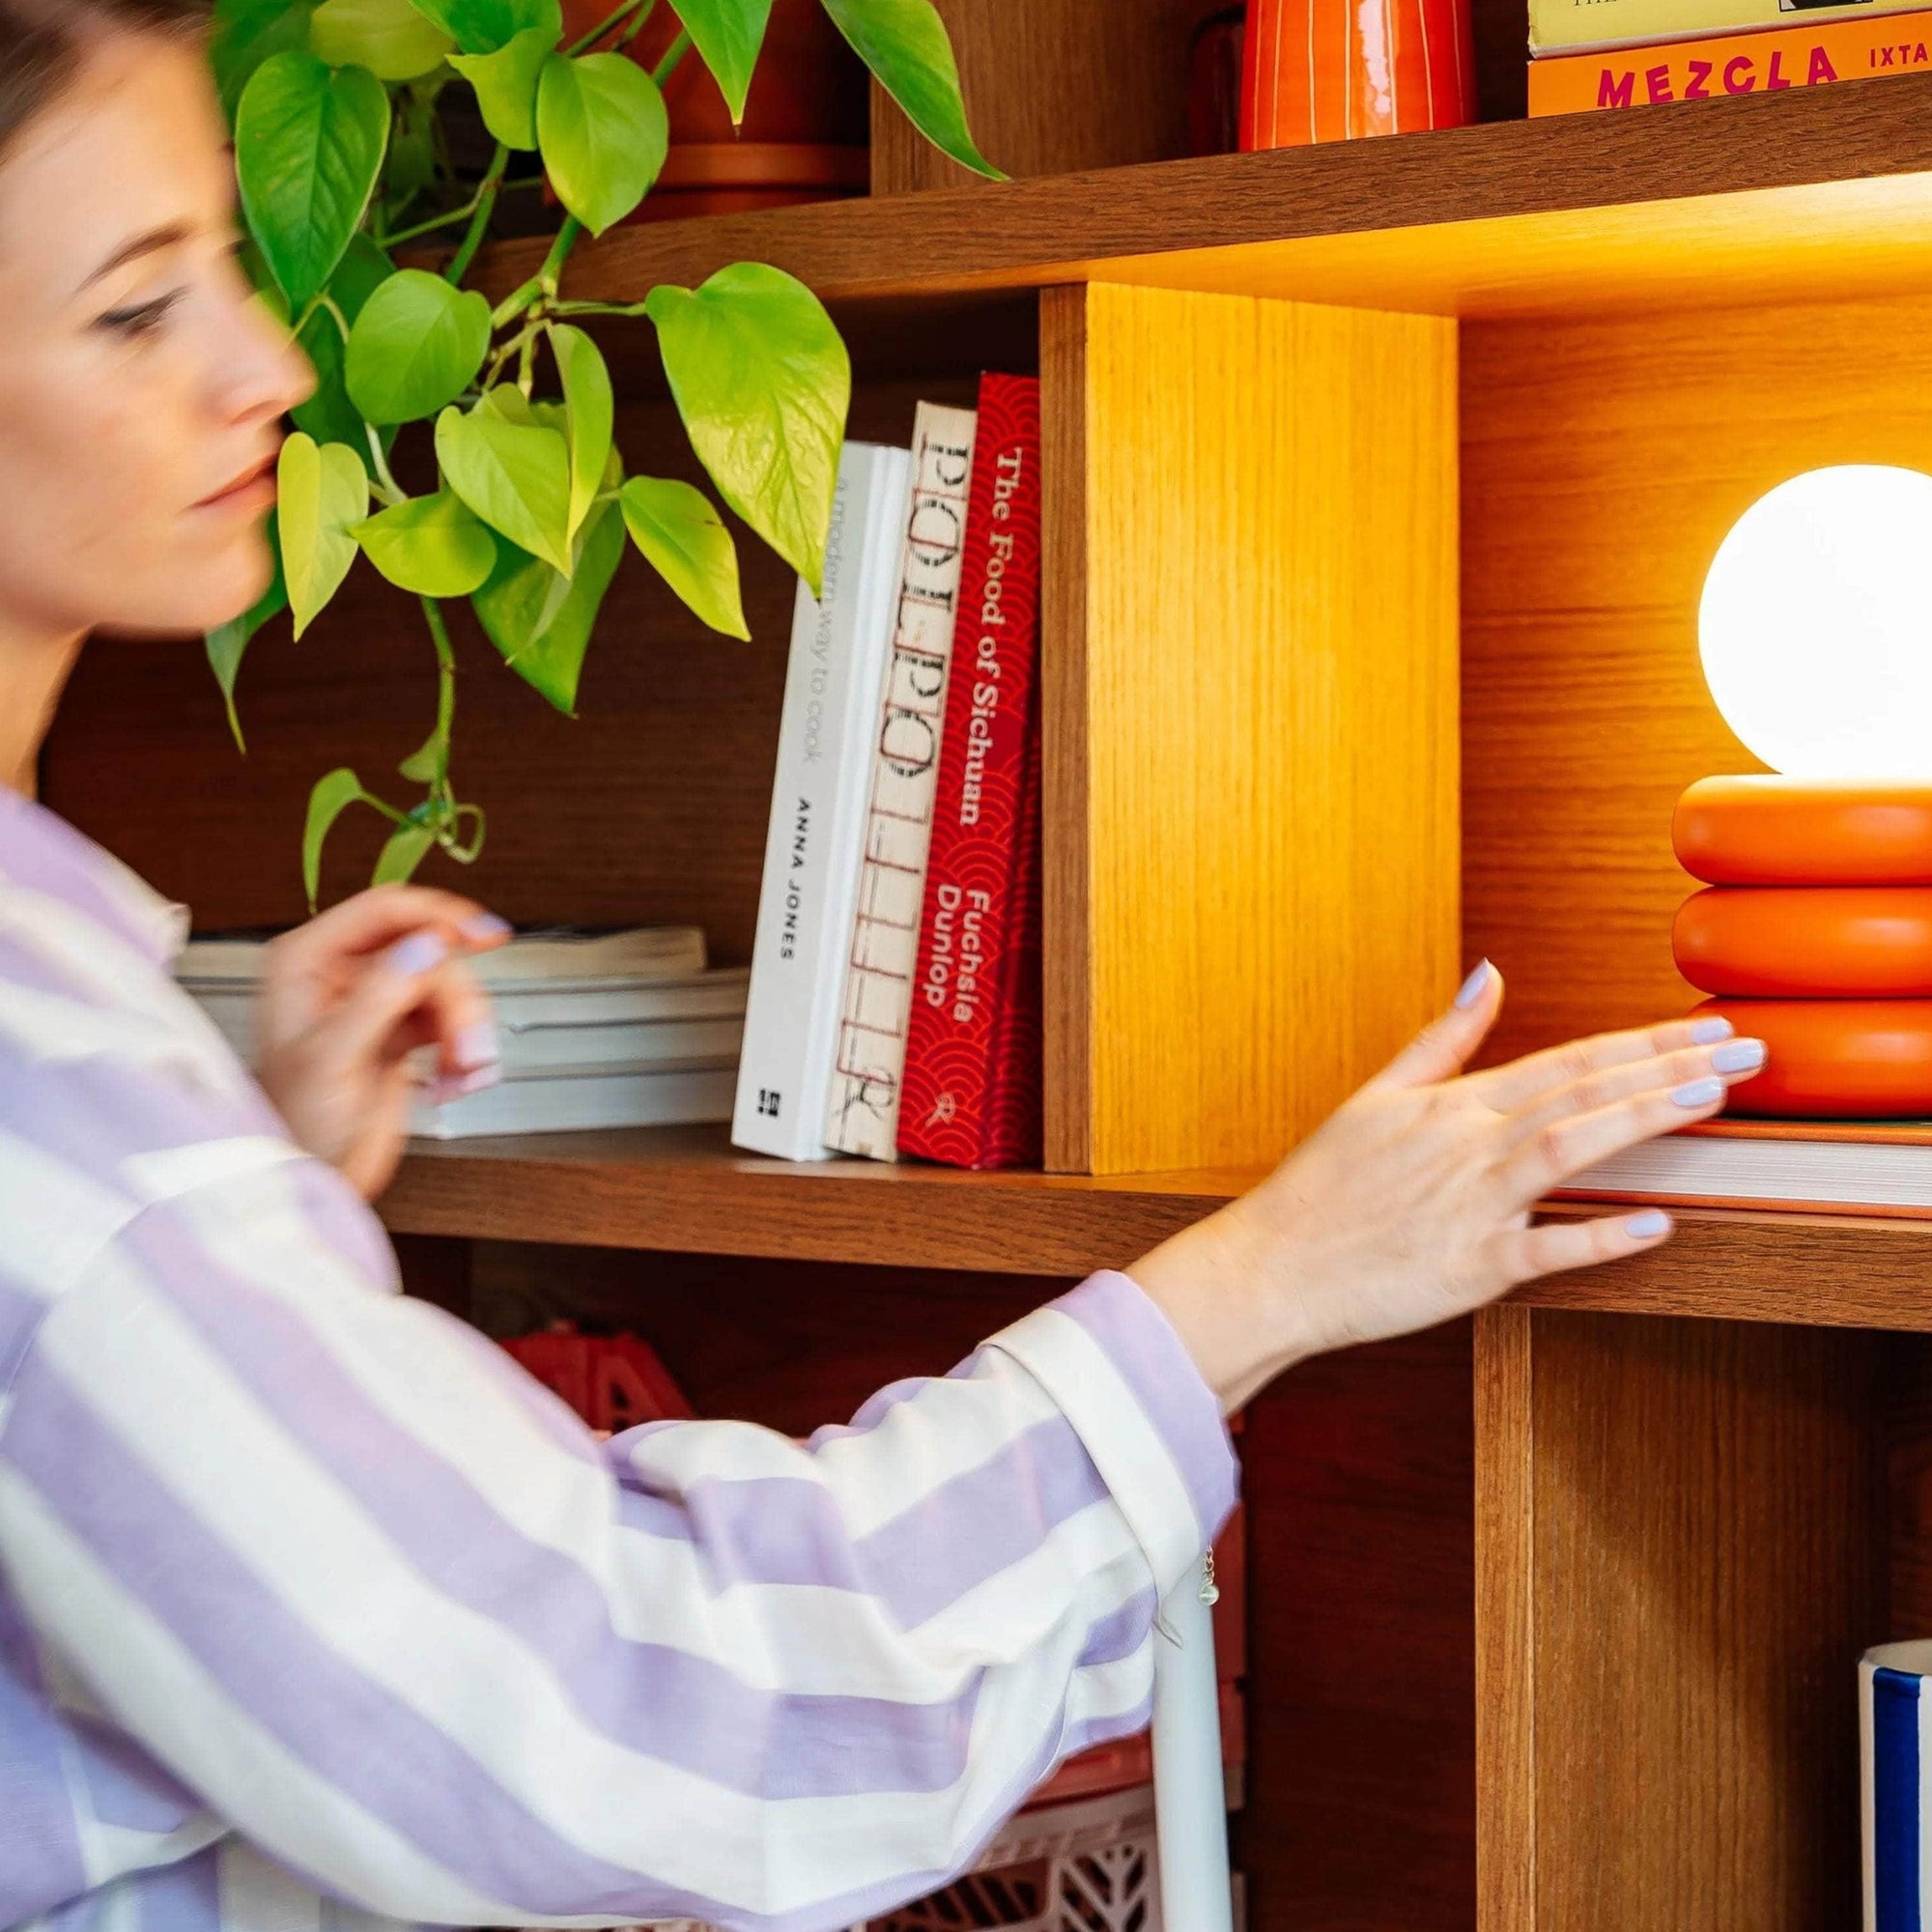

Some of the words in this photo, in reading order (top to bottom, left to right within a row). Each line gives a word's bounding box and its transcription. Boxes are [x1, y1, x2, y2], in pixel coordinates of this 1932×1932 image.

[1597, 46, 1838, 108] MEZCLA
[1870, 43, 1929, 68] IXTA
[992, 447, 1023, 521] The
[880, 435, 969, 778] POLPO
[981, 532, 1014, 625] Food
[810, 610, 834, 663] way
[977, 636, 1002, 679] of
[810, 668, 829, 696] to
[802, 699, 823, 764] cook
[960, 682, 999, 827] Sichuan
[791, 797, 811, 869] ANNA
[780, 878, 802, 960] JONES
[923, 884, 962, 1008] Dunlop
[952, 889, 991, 1023] Fuchsia
